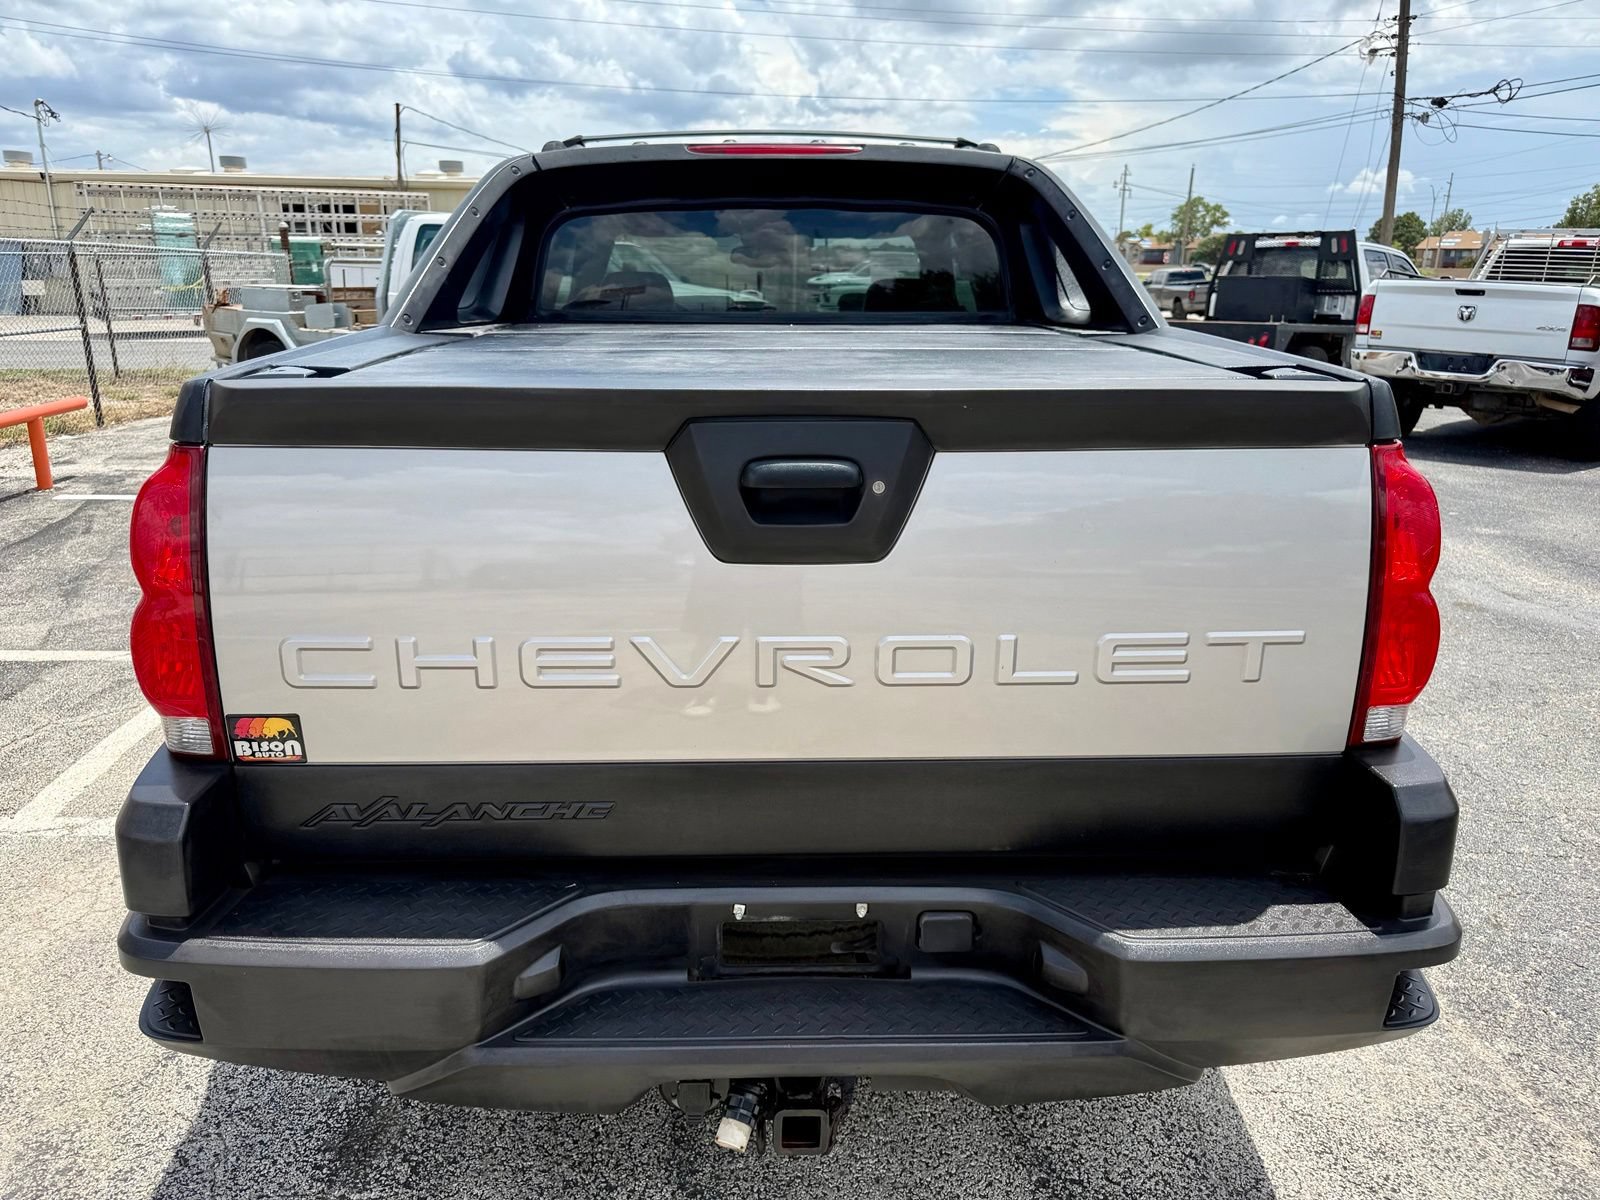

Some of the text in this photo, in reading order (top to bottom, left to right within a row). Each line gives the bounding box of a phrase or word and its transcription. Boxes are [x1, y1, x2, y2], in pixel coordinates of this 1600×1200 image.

[279, 630, 1306, 689] CHEVROLET
[234, 740, 302, 757] BISON
[254, 751, 284, 759] AUTO
[300, 796, 616, 828] AVALANCHE
